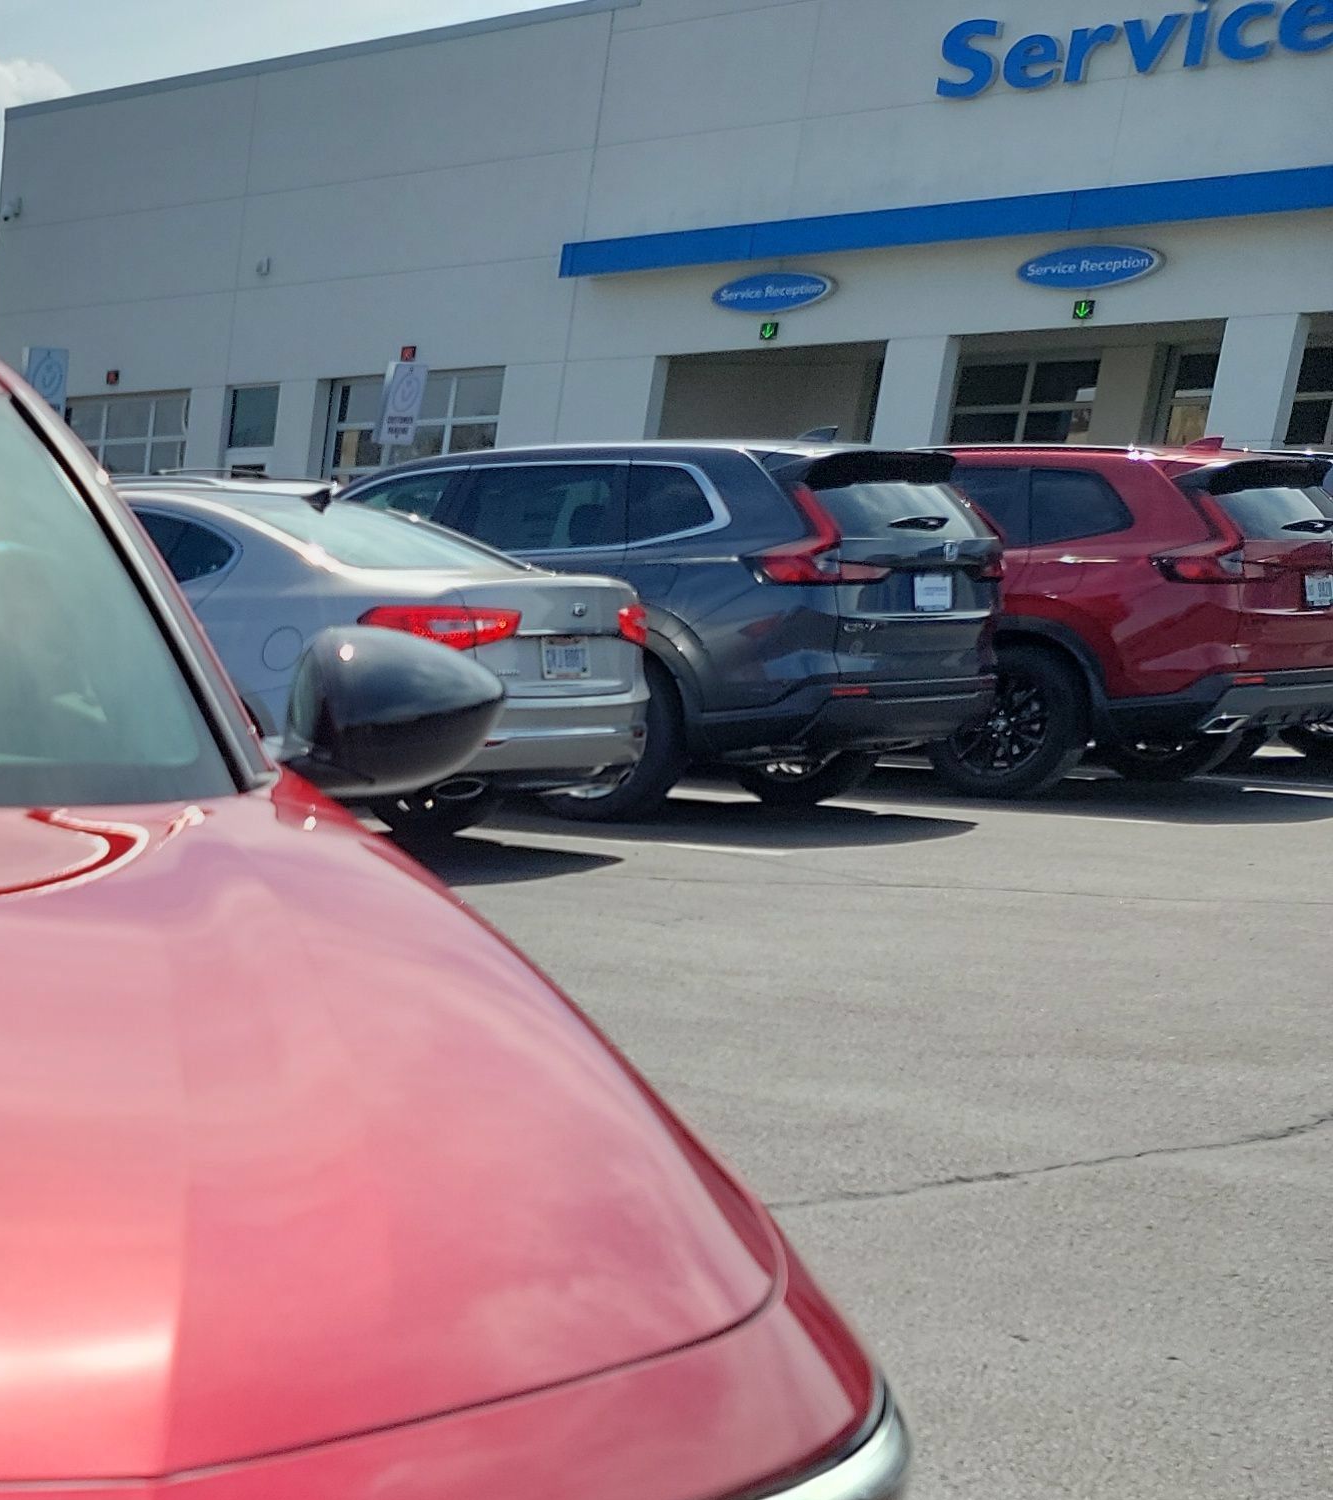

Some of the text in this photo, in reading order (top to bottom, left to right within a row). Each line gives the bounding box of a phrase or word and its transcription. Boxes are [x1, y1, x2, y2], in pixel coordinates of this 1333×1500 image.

[935, 0, 1333, 99] Service
[1026, 256, 1150, 277] Service Reception
[720, 283, 824, 301] Service Reception
